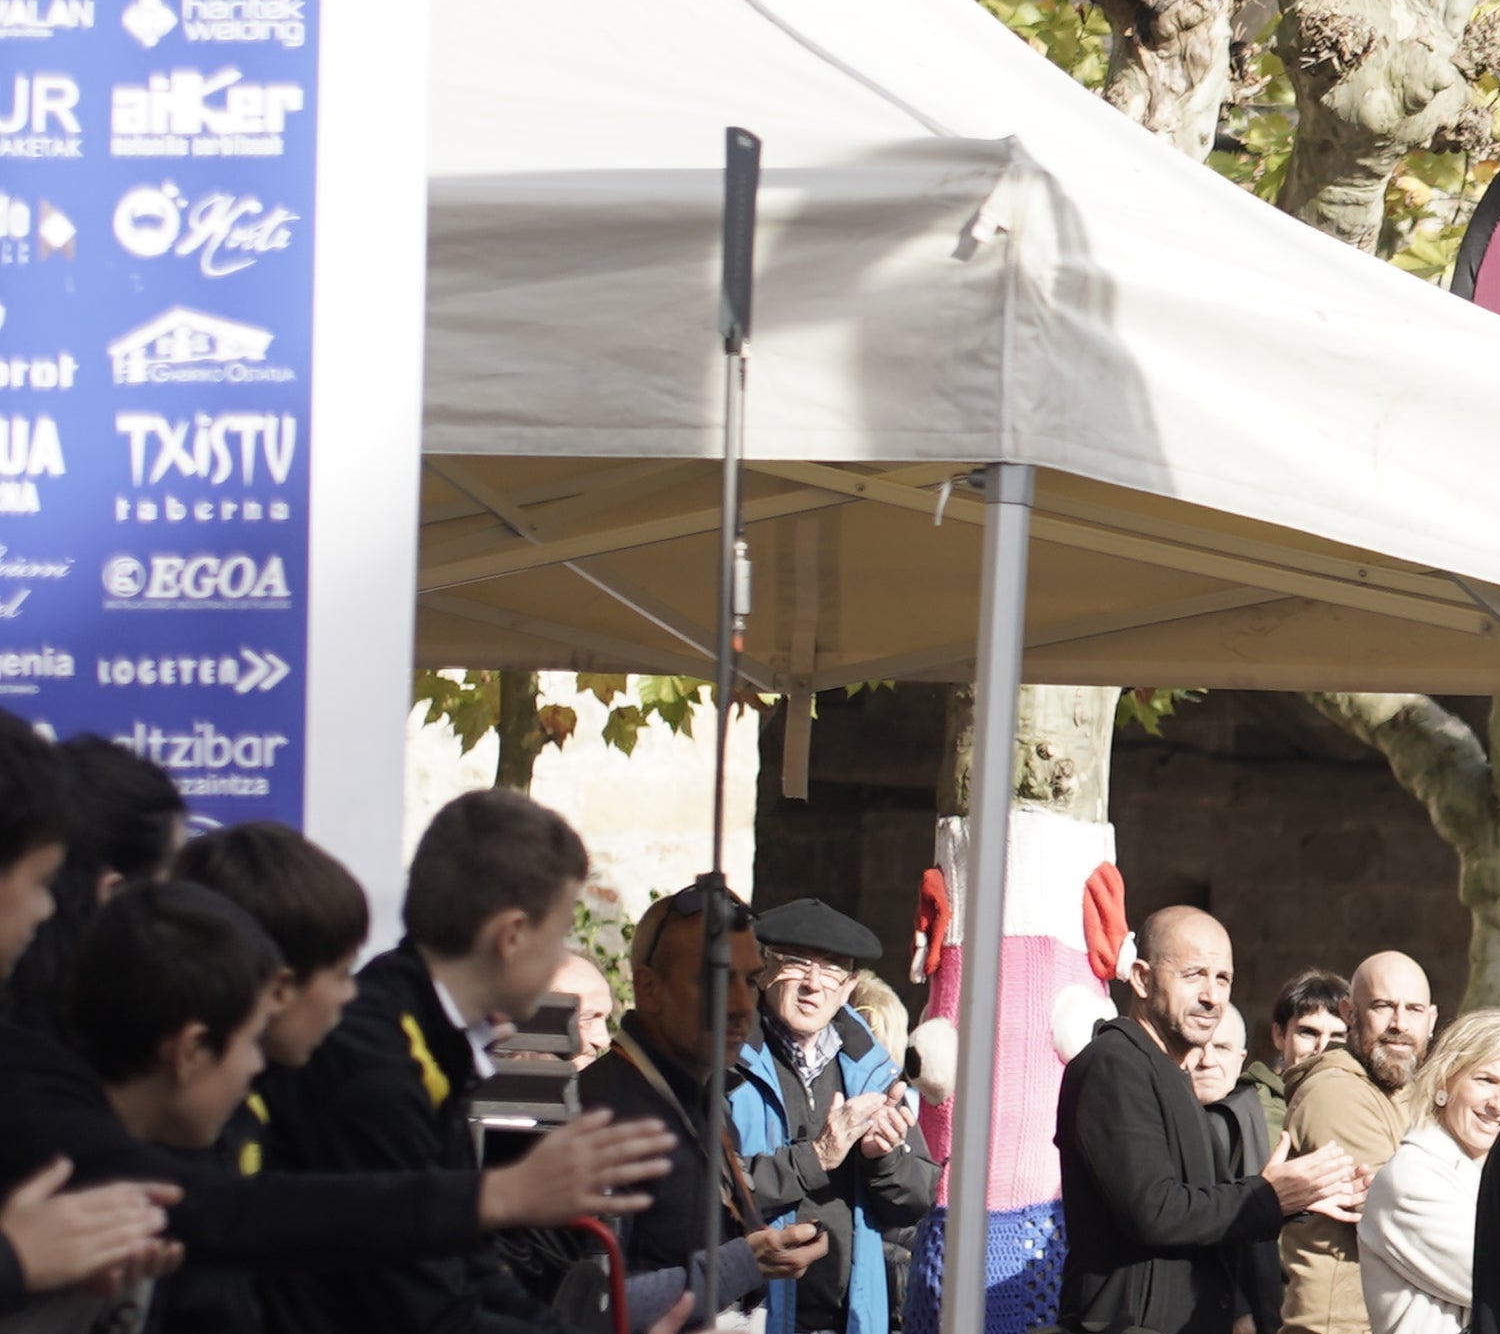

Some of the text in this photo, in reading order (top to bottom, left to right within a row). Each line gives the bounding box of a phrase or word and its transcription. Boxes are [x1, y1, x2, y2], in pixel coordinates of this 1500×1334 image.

[115, 495, 291, 522] taberna
[145, 555, 292, 599] EGOA
[0, 646, 76, 678] enia
